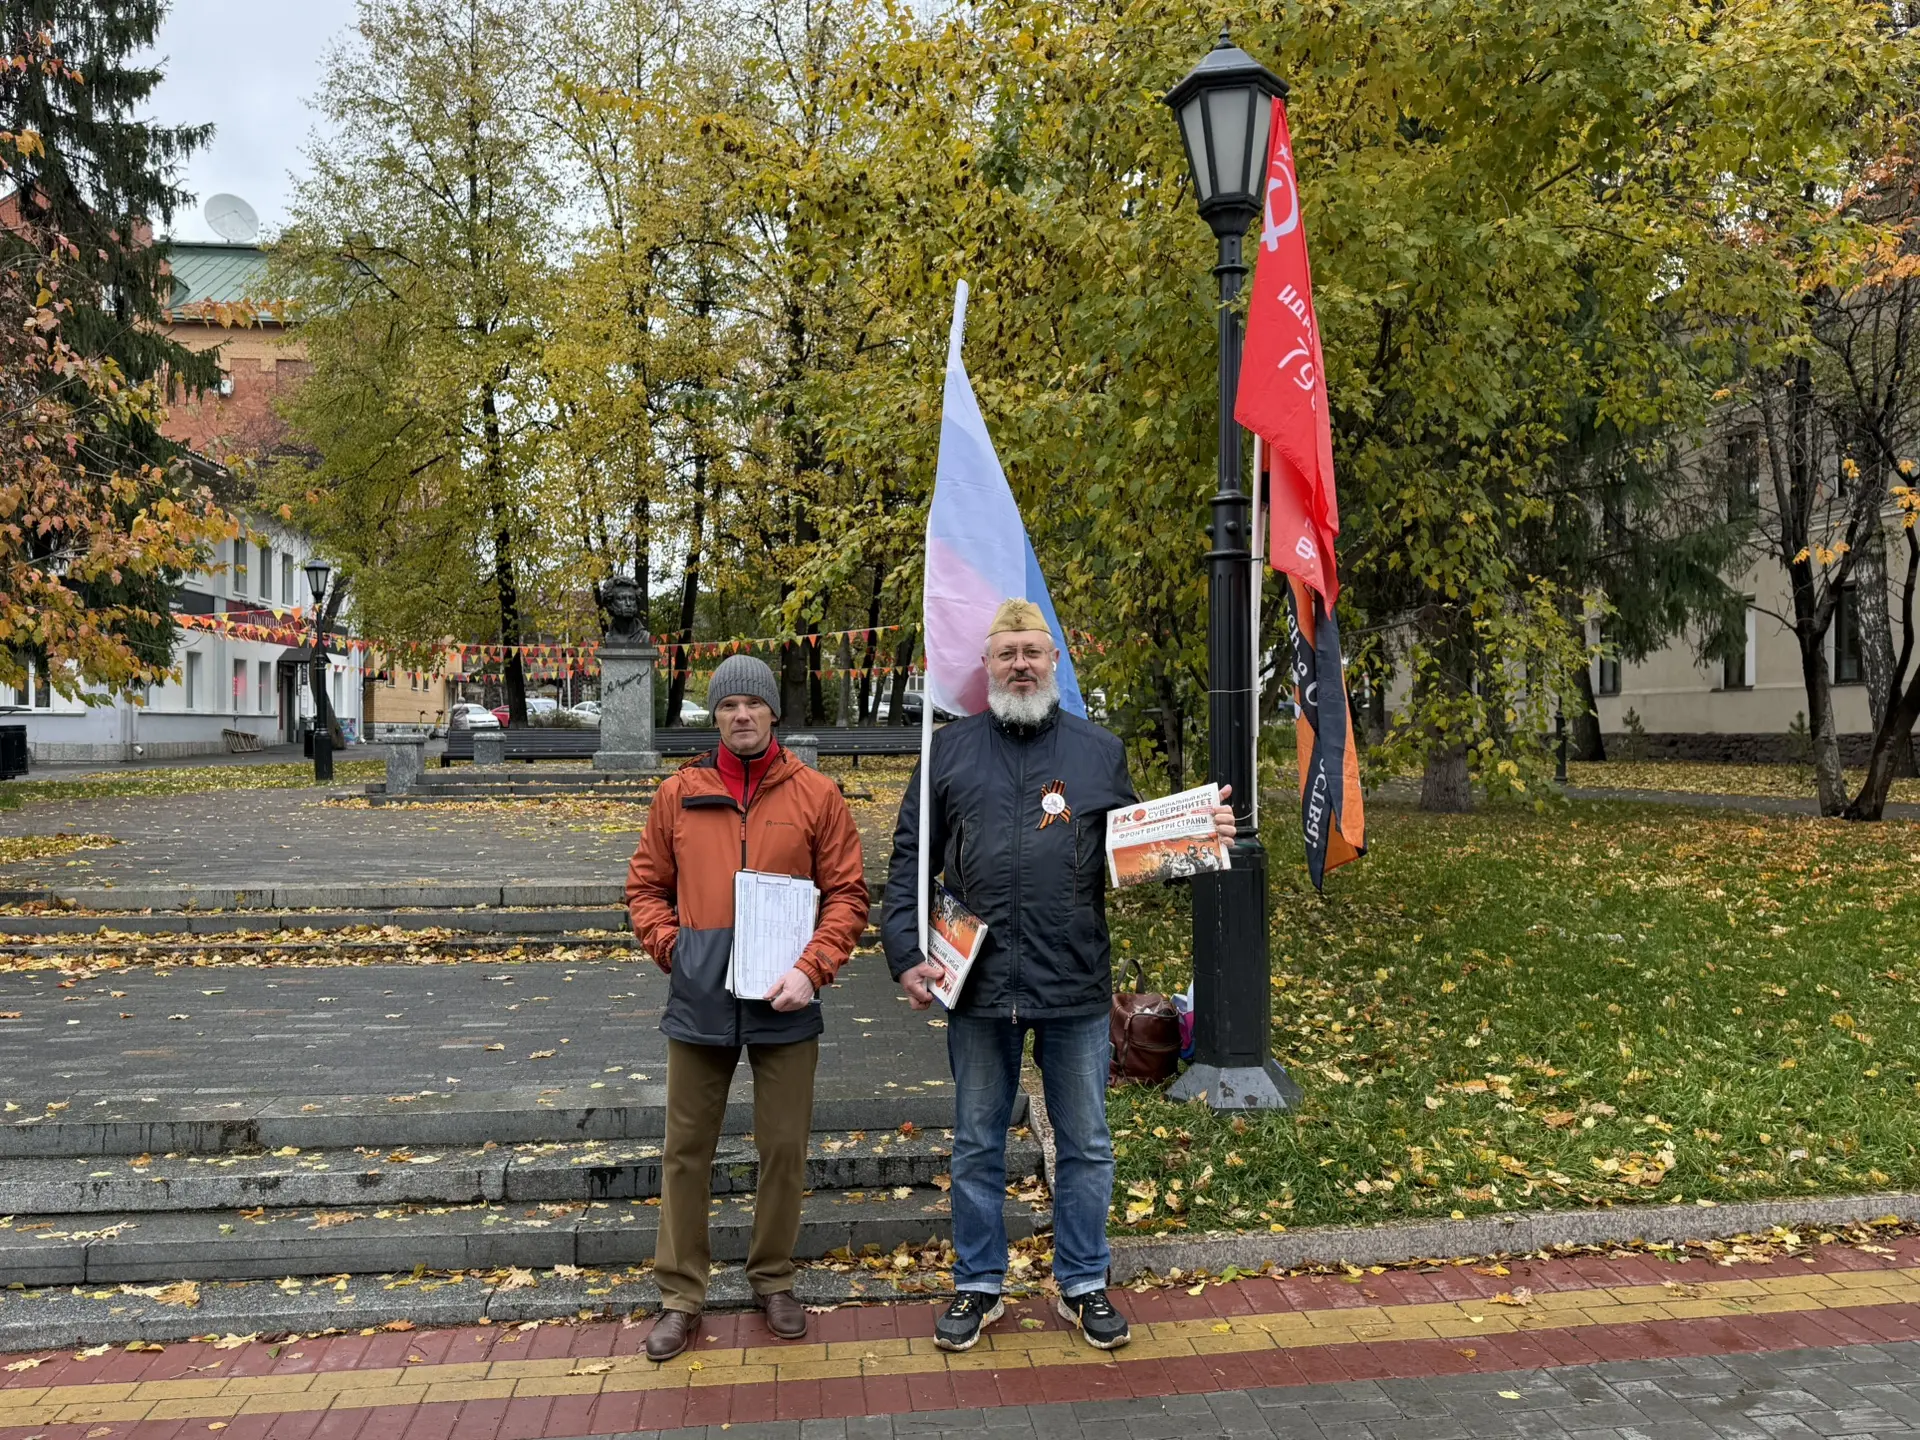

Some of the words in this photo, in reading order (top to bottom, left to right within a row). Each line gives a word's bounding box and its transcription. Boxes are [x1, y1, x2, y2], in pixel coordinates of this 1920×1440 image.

[1278, 336, 1315, 391] 79
[1148, 798, 1212, 819] СУВЕРЕНИТЕТ
[1119, 829, 1146, 839] ФРОНТ
[1146, 822, 1176, 834] ВНУТРИ
[1176, 816, 1208, 830] СТРАНЫ
